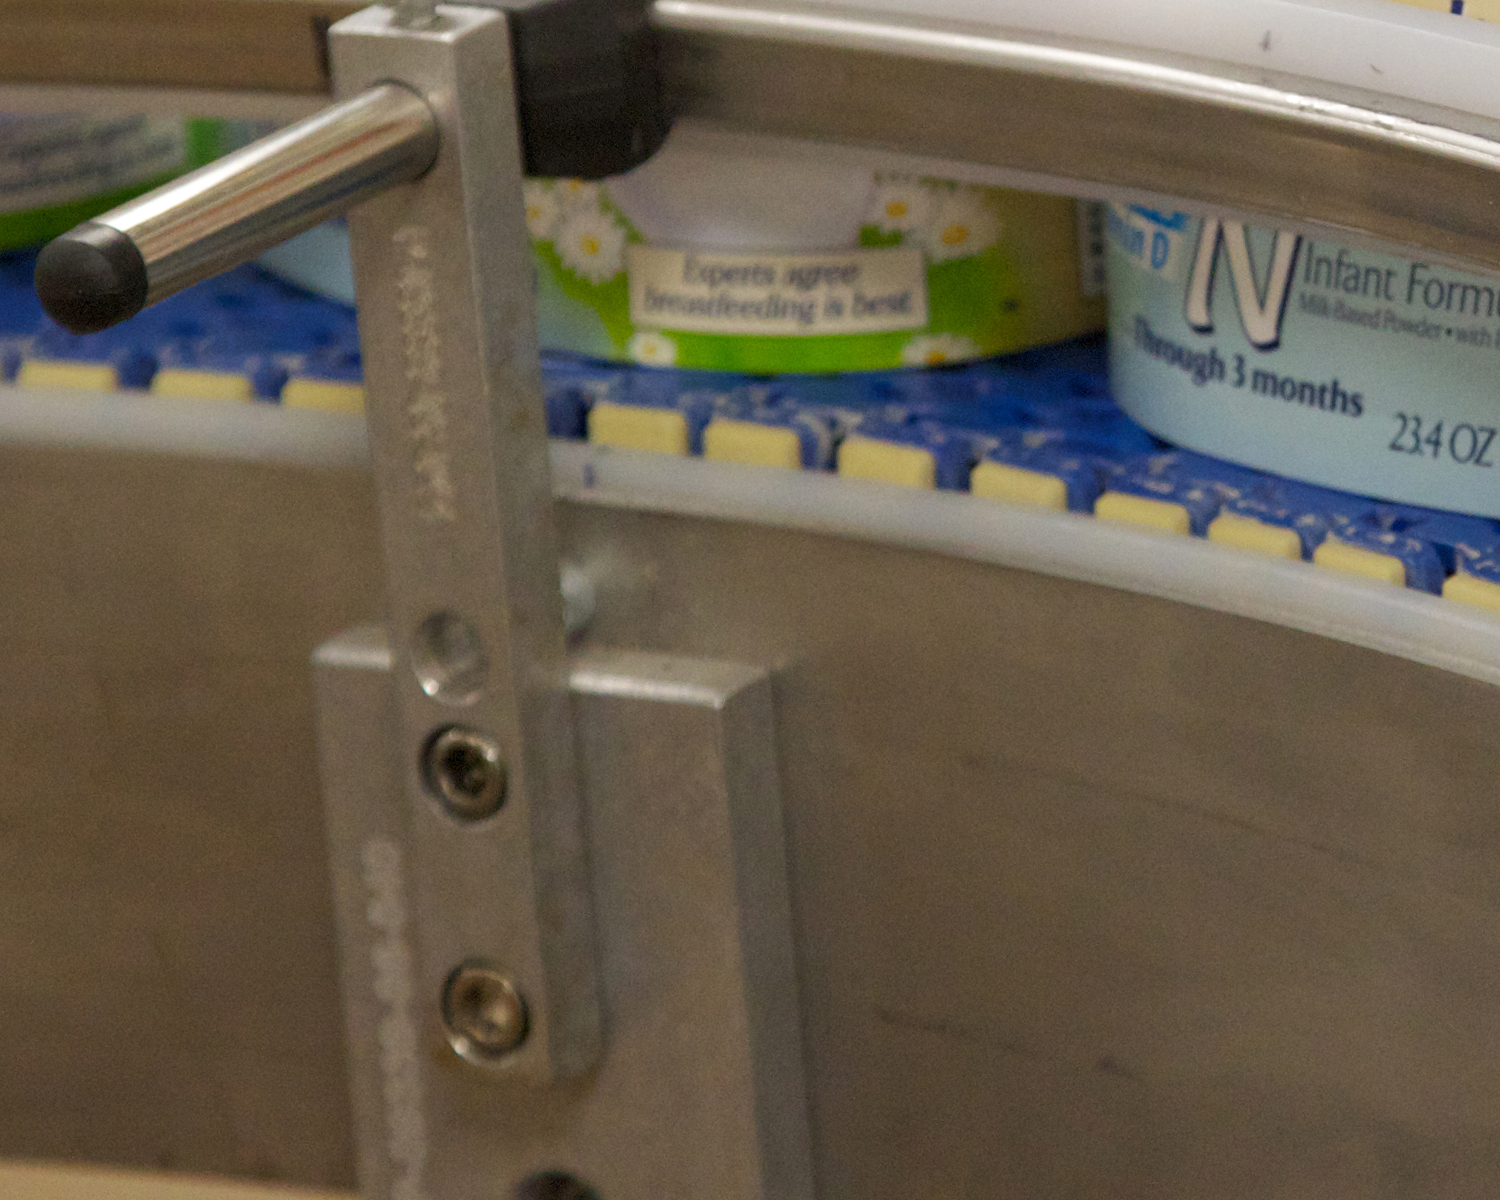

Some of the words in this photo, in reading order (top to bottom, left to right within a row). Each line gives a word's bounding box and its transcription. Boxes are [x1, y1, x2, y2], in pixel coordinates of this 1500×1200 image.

[1303, 242, 1397, 300] Infant
[1455, 326, 1492, 349] with
[1232, 354, 1247, 389] 3
[1251, 368, 1366, 419] months
[1450, 422, 1497, 468] OZ
